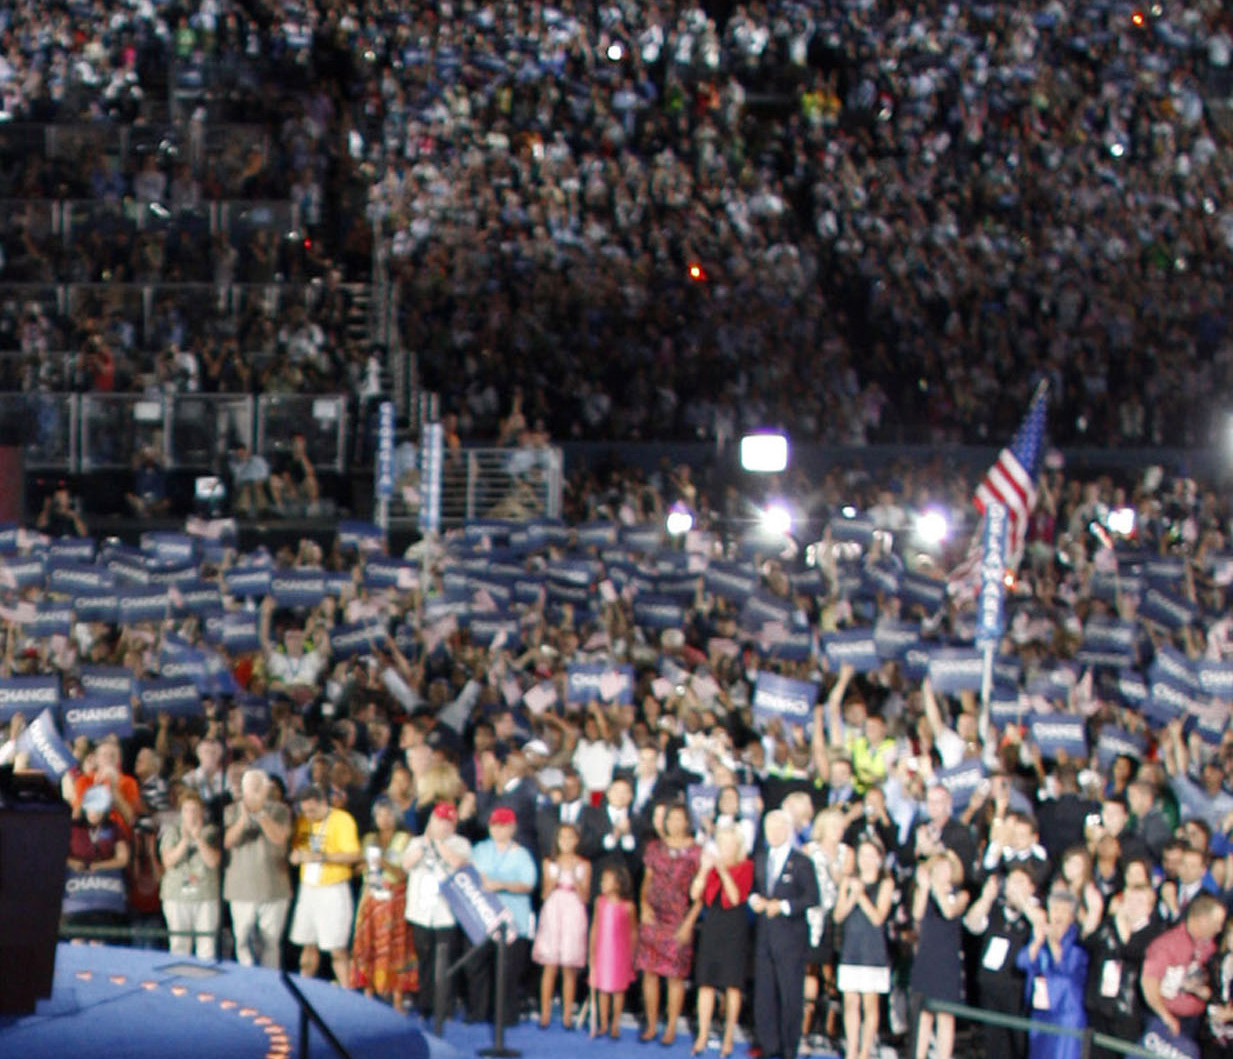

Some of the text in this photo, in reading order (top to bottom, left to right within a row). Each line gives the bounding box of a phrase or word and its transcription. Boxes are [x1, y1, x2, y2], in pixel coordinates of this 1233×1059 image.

[272, 579, 325, 590] CHANGE
[82, 676, 130, 690] CHANGE
[142, 684, 197, 700] CHANGE
[67, 706, 128, 722] CHANGE
[29, 718, 68, 773] CHANGE
[65, 877, 120, 893] CHANGE
